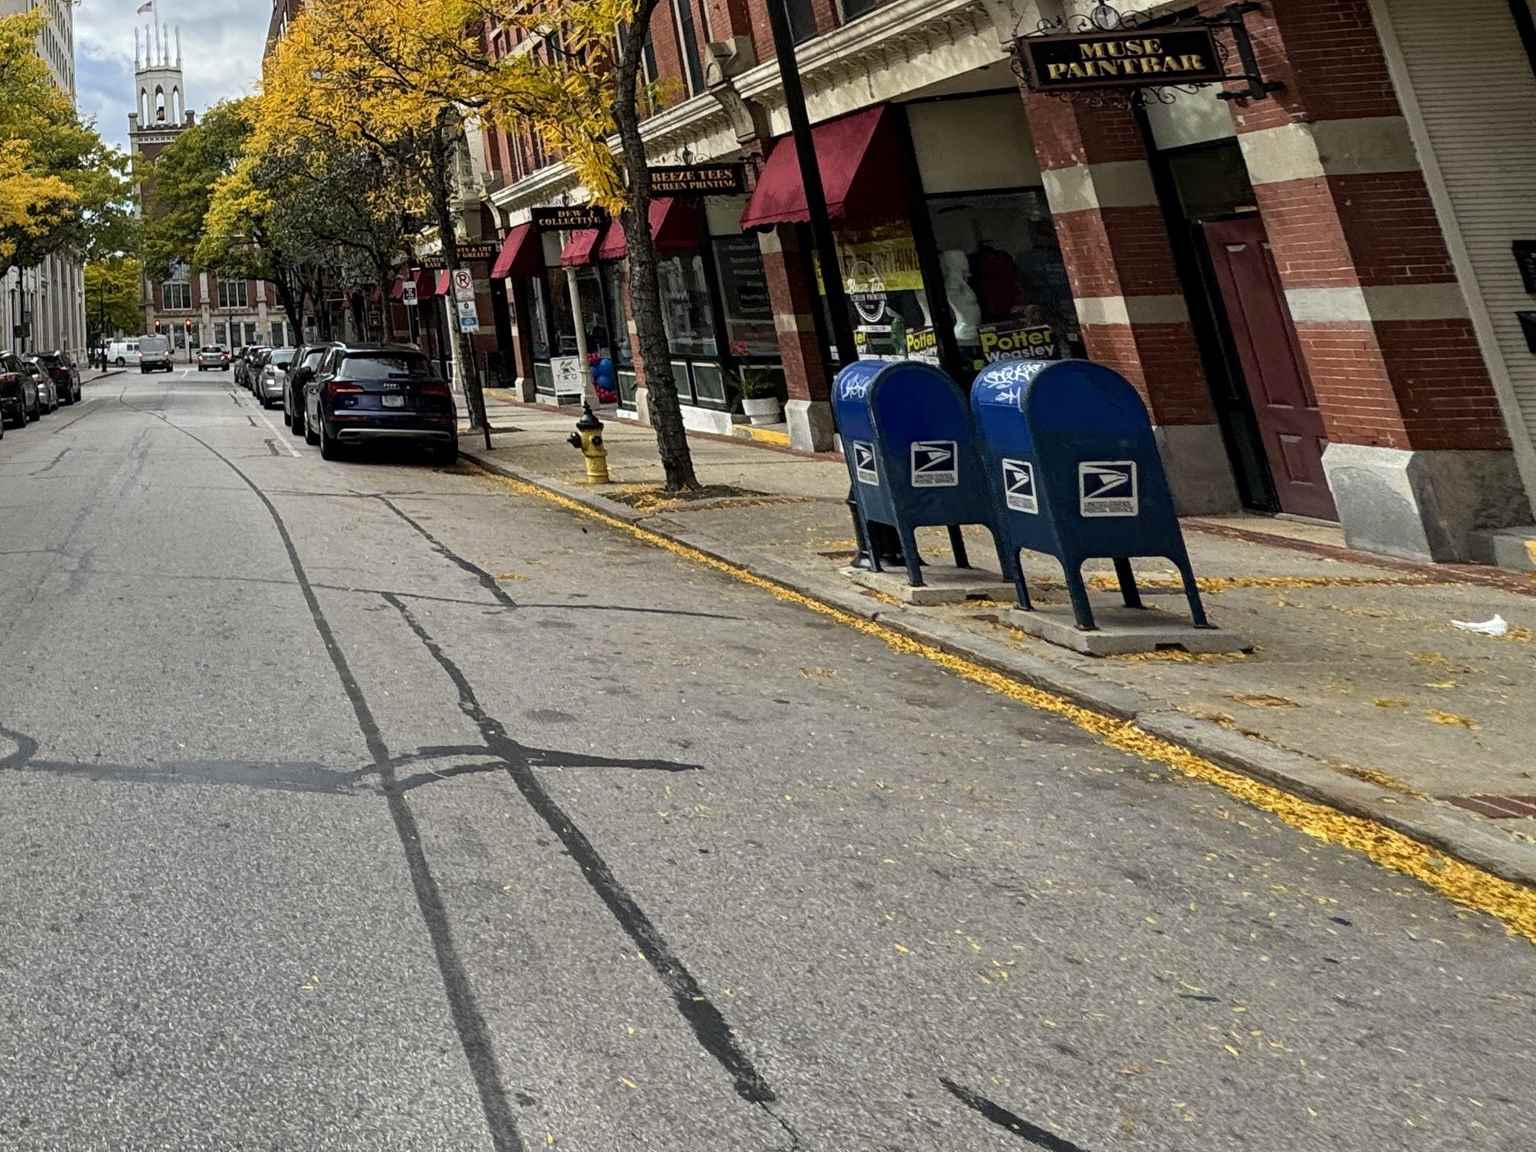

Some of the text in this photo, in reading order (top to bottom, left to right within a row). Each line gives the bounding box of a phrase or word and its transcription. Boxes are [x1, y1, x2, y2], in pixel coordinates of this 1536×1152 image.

[1079, 39, 1163, 59] MUSE
[1047, 55, 1206, 79] PAINTBAR
[698, 168, 734, 180] TEES
[651, 180, 737, 191] SCREEN PRINTING
[539, 216, 601, 227] COLLECTIVE
[979, 331, 1053, 353] Potter
[984, 345, 1055, 362] Weasley
